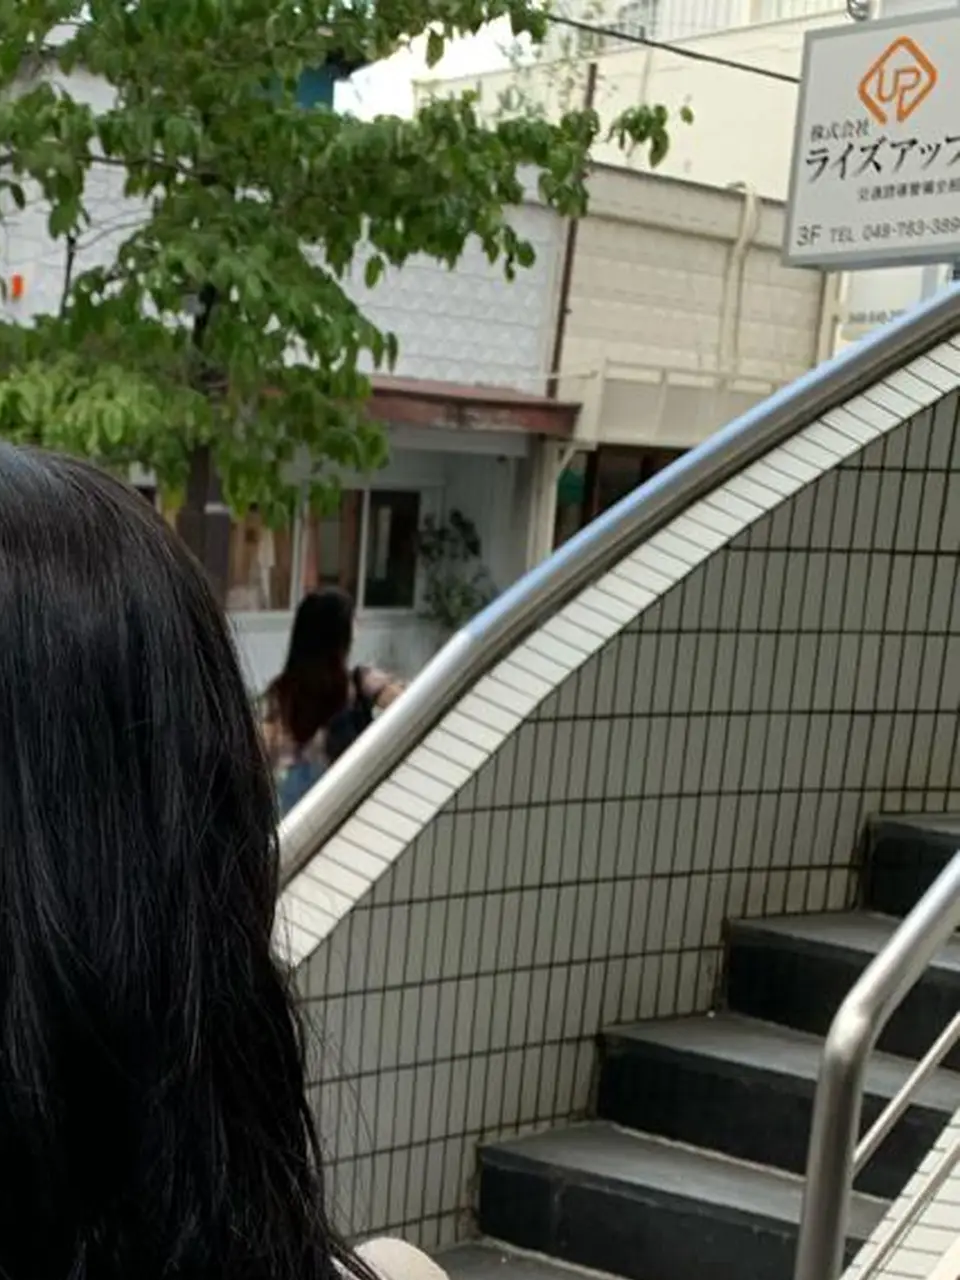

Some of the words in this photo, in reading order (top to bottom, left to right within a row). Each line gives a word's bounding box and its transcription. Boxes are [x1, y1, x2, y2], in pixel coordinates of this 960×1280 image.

[810, 119, 869, 141] 株式会社
[796, 224, 822, 247] 3F
[830, 226, 854, 243] TEL
